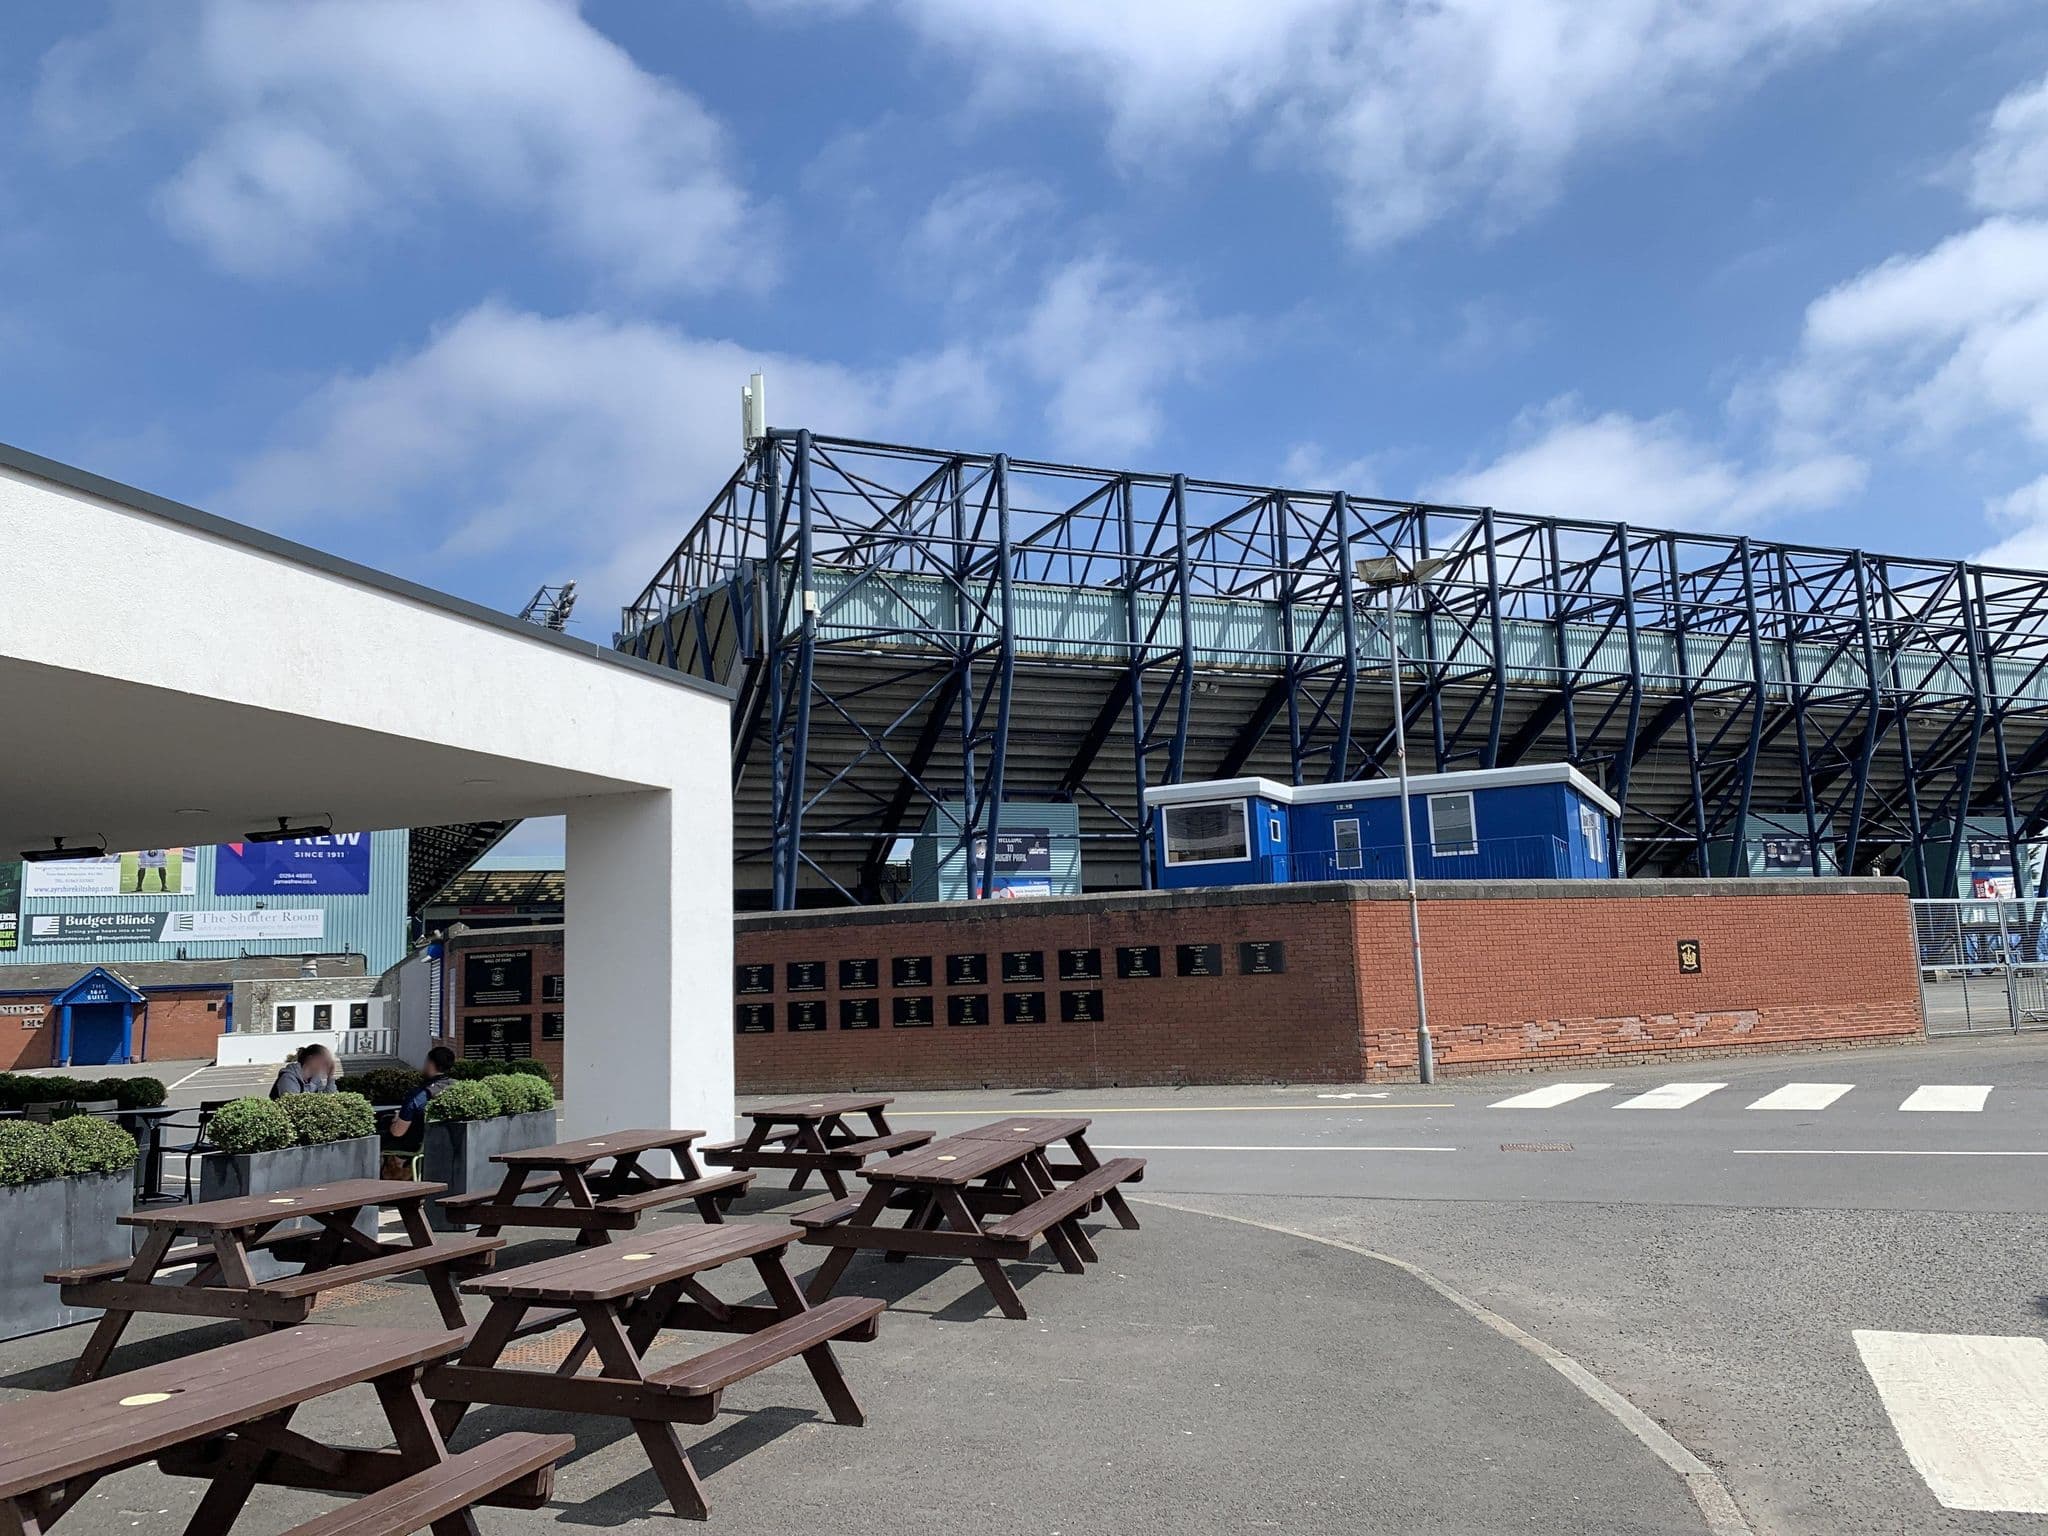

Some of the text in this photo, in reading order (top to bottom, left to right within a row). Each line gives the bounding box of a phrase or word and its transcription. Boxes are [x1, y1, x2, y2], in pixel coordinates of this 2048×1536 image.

[1007, 844, 1014, 852] TO
[1012, 853, 1027, 862] PARK
[65, 914, 156, 928] Budget Blinds
[201, 911, 319, 923] The Shutter Room
